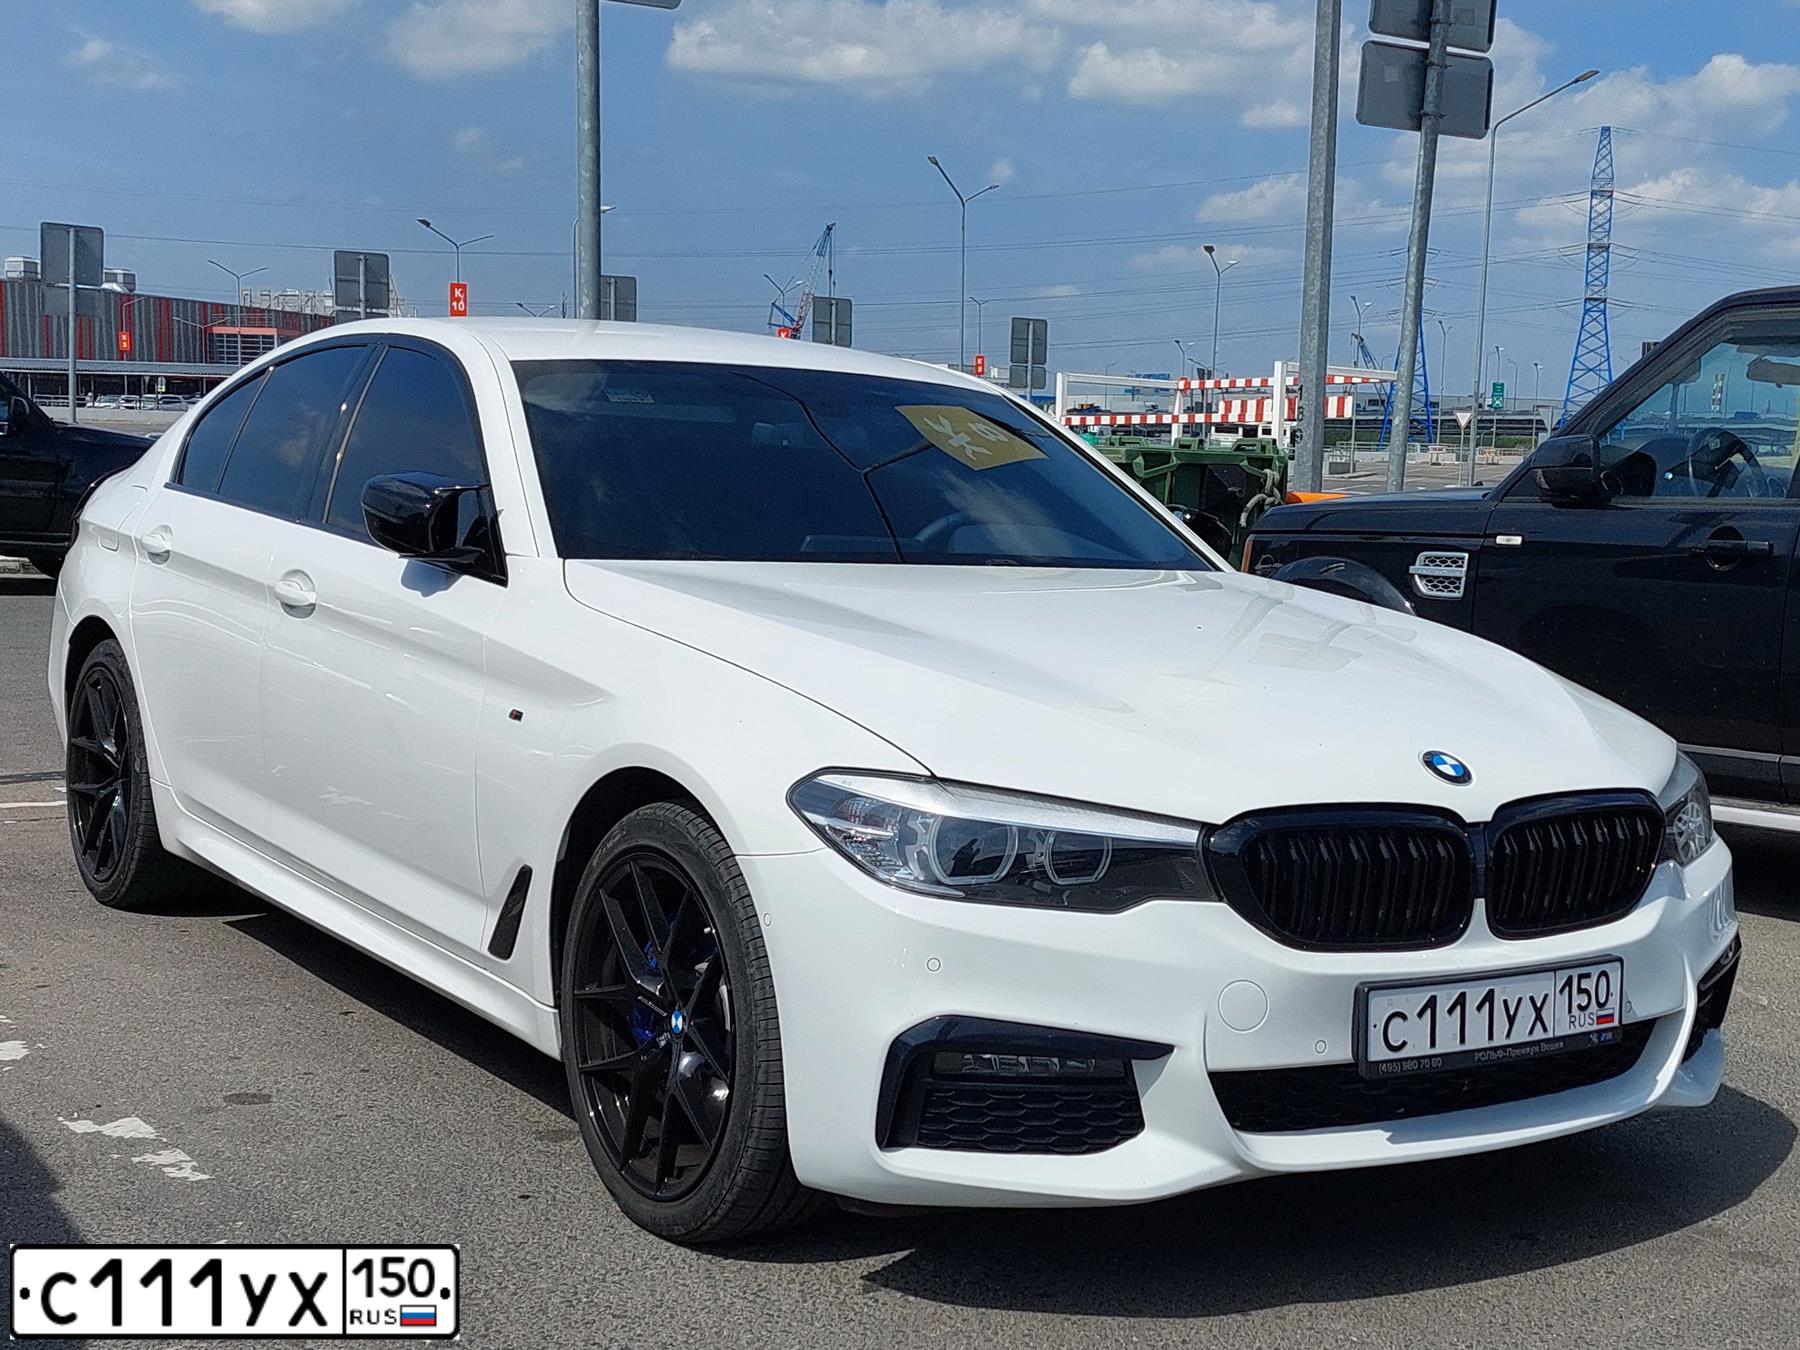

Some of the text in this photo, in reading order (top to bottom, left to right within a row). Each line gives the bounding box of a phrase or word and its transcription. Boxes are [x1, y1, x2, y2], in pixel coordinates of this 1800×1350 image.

[452, 301, 465, 311] 10
[1559, 970, 1611, 1015] 150
[1382, 988, 1549, 1052] С111УХ
[1569, 1012, 1595, 1030] RUS
